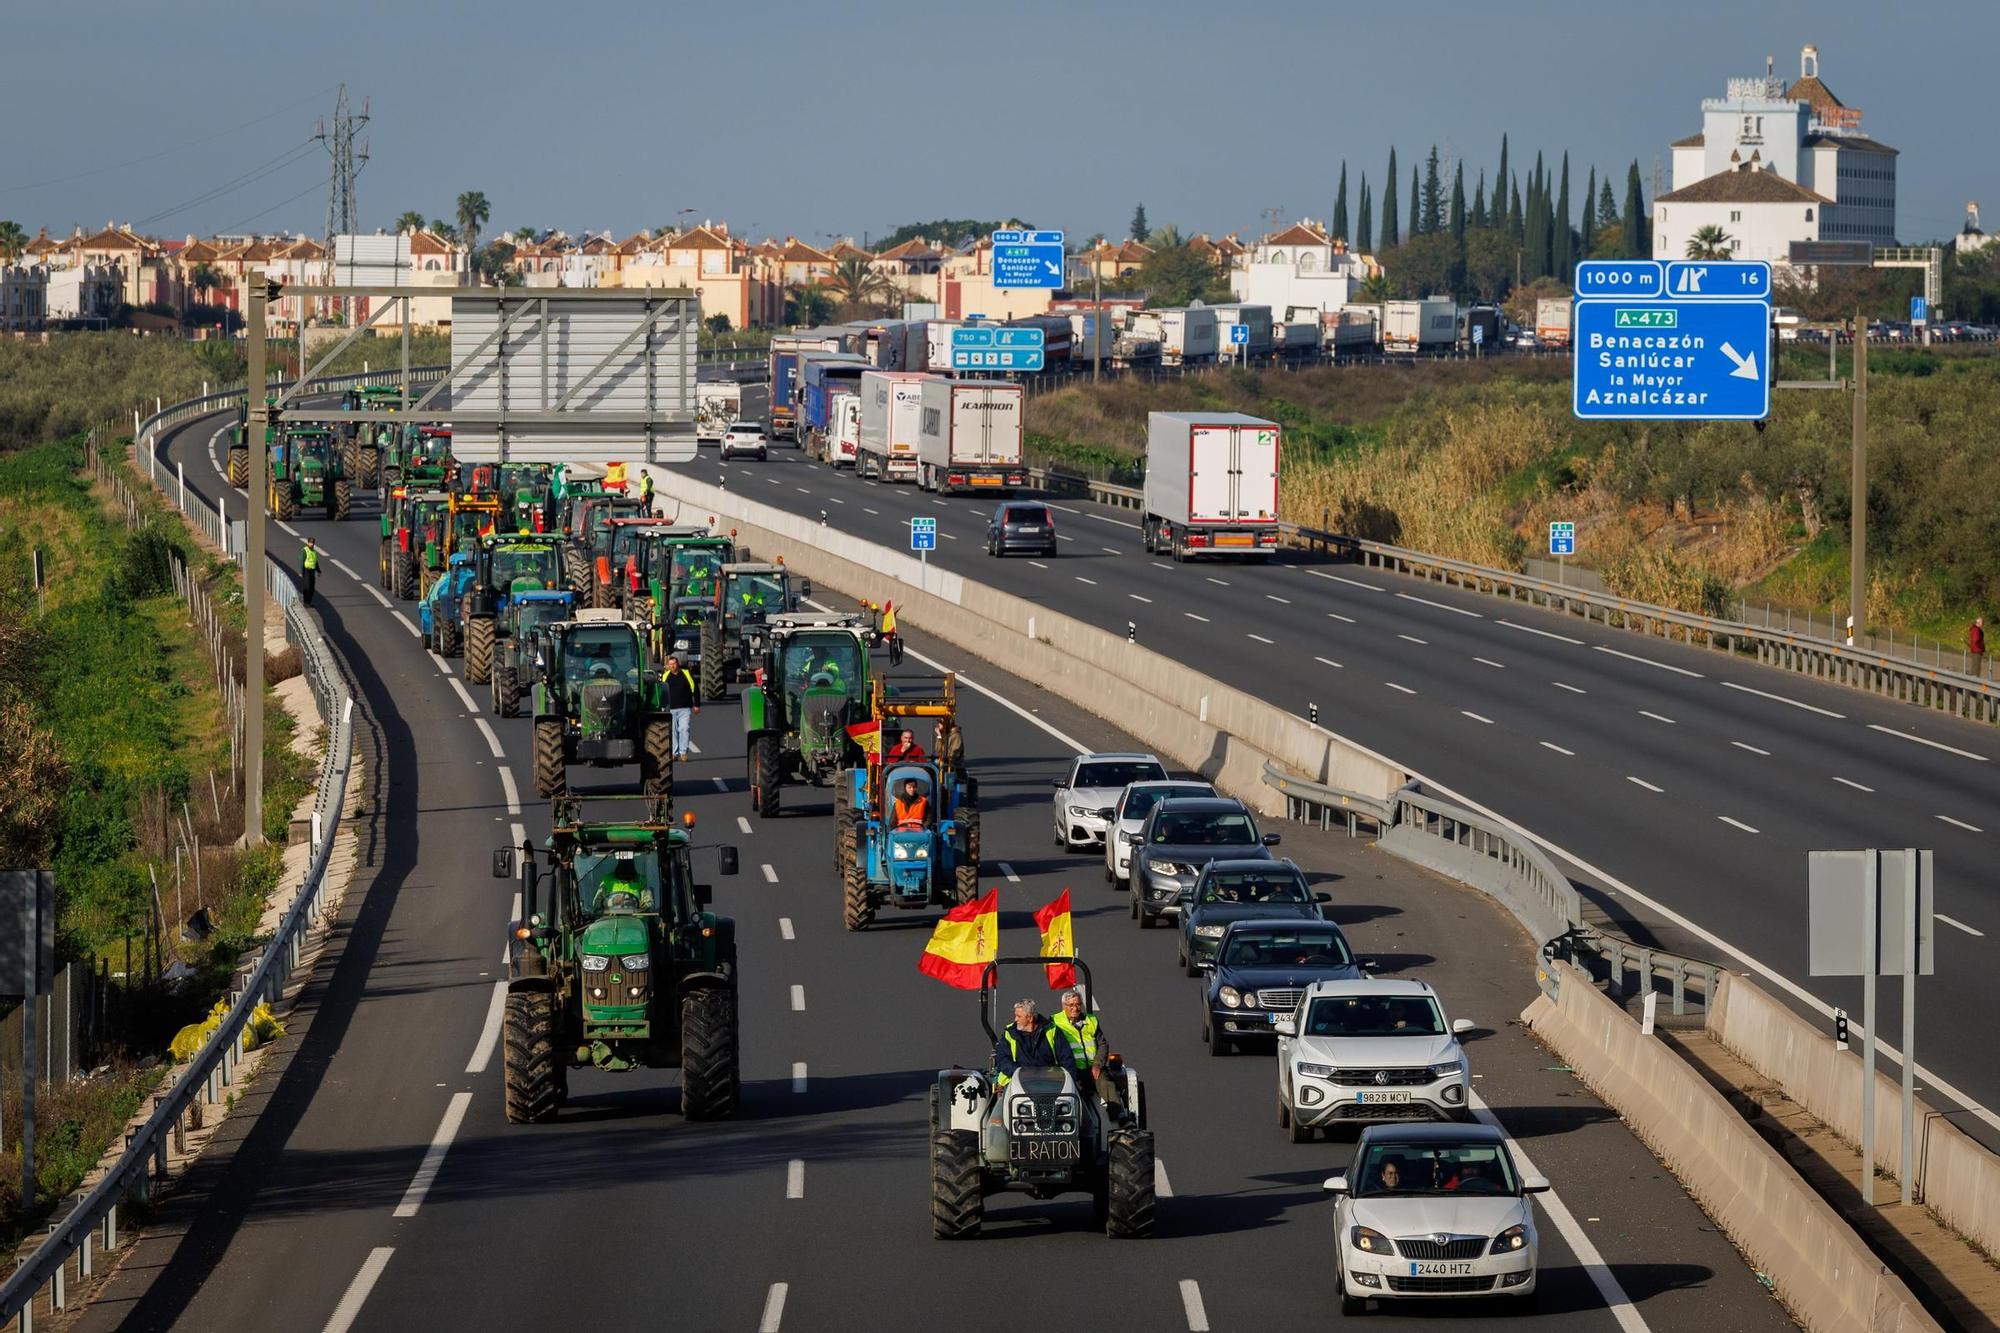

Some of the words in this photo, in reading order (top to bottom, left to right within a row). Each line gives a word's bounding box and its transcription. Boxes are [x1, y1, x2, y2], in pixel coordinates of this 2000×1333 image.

[1586, 272, 1632, 284] 1000
[1639, 274, 1652, 284] m
[1741, 272, 1759, 285] 16
[1619, 312, 1674, 325] A-473
[1590, 333, 1704, 349] Benacazón
[1599, 351, 1695, 368] Sanlúcar
[1610, 374, 1624, 386] la
[1633, 373, 1683, 389] Mayor
[1586, 388, 1708, 405] Aznalcázar
[1363, 1093, 1387, 1103] 9828
[1390, 1093, 1408, 1103] MCV
[1010, 1141, 1027, 1160] EL
[1029, 1140, 1081, 1160] RATON
[1418, 1263, 1447, 1275] 2440
[1450, 1263, 1471, 1275] HTZ
